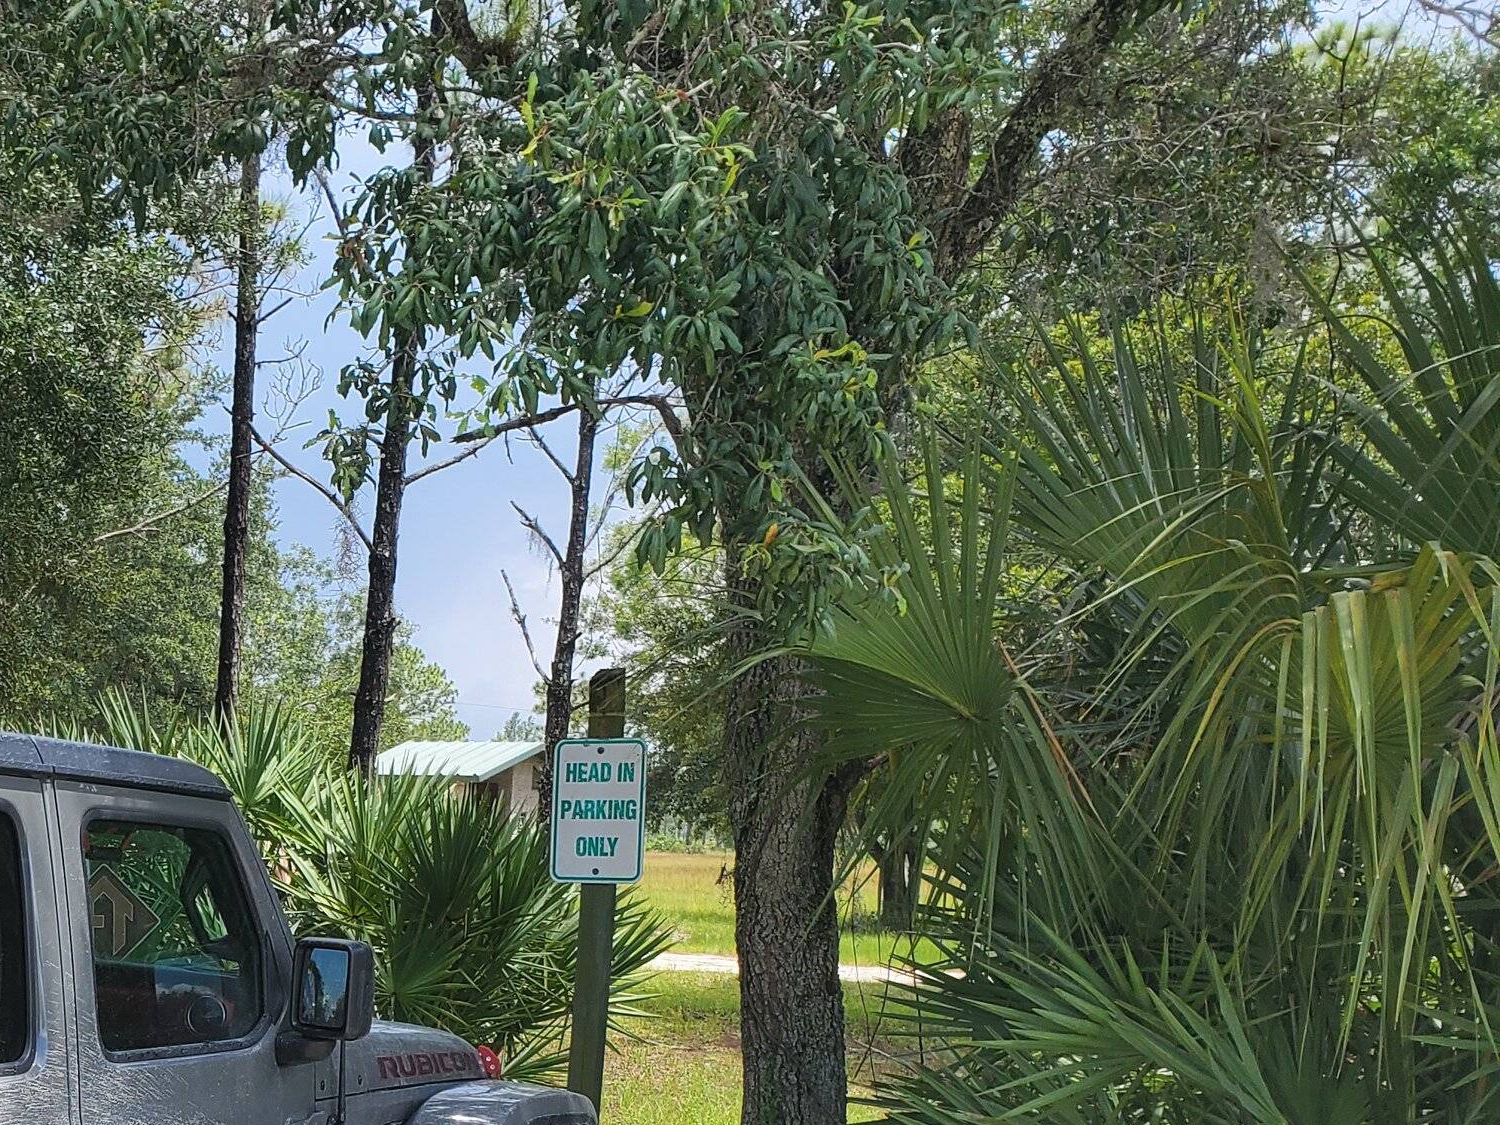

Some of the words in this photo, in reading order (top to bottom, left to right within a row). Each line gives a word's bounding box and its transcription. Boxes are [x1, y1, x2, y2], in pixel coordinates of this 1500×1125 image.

[565, 762, 612, 783] HEAD
[617, 762, 635, 783] IN
[560, 799, 637, 820] PARKING
[575, 836, 620, 857] ONLY
[375, 1051, 478, 1079] RUBICON
